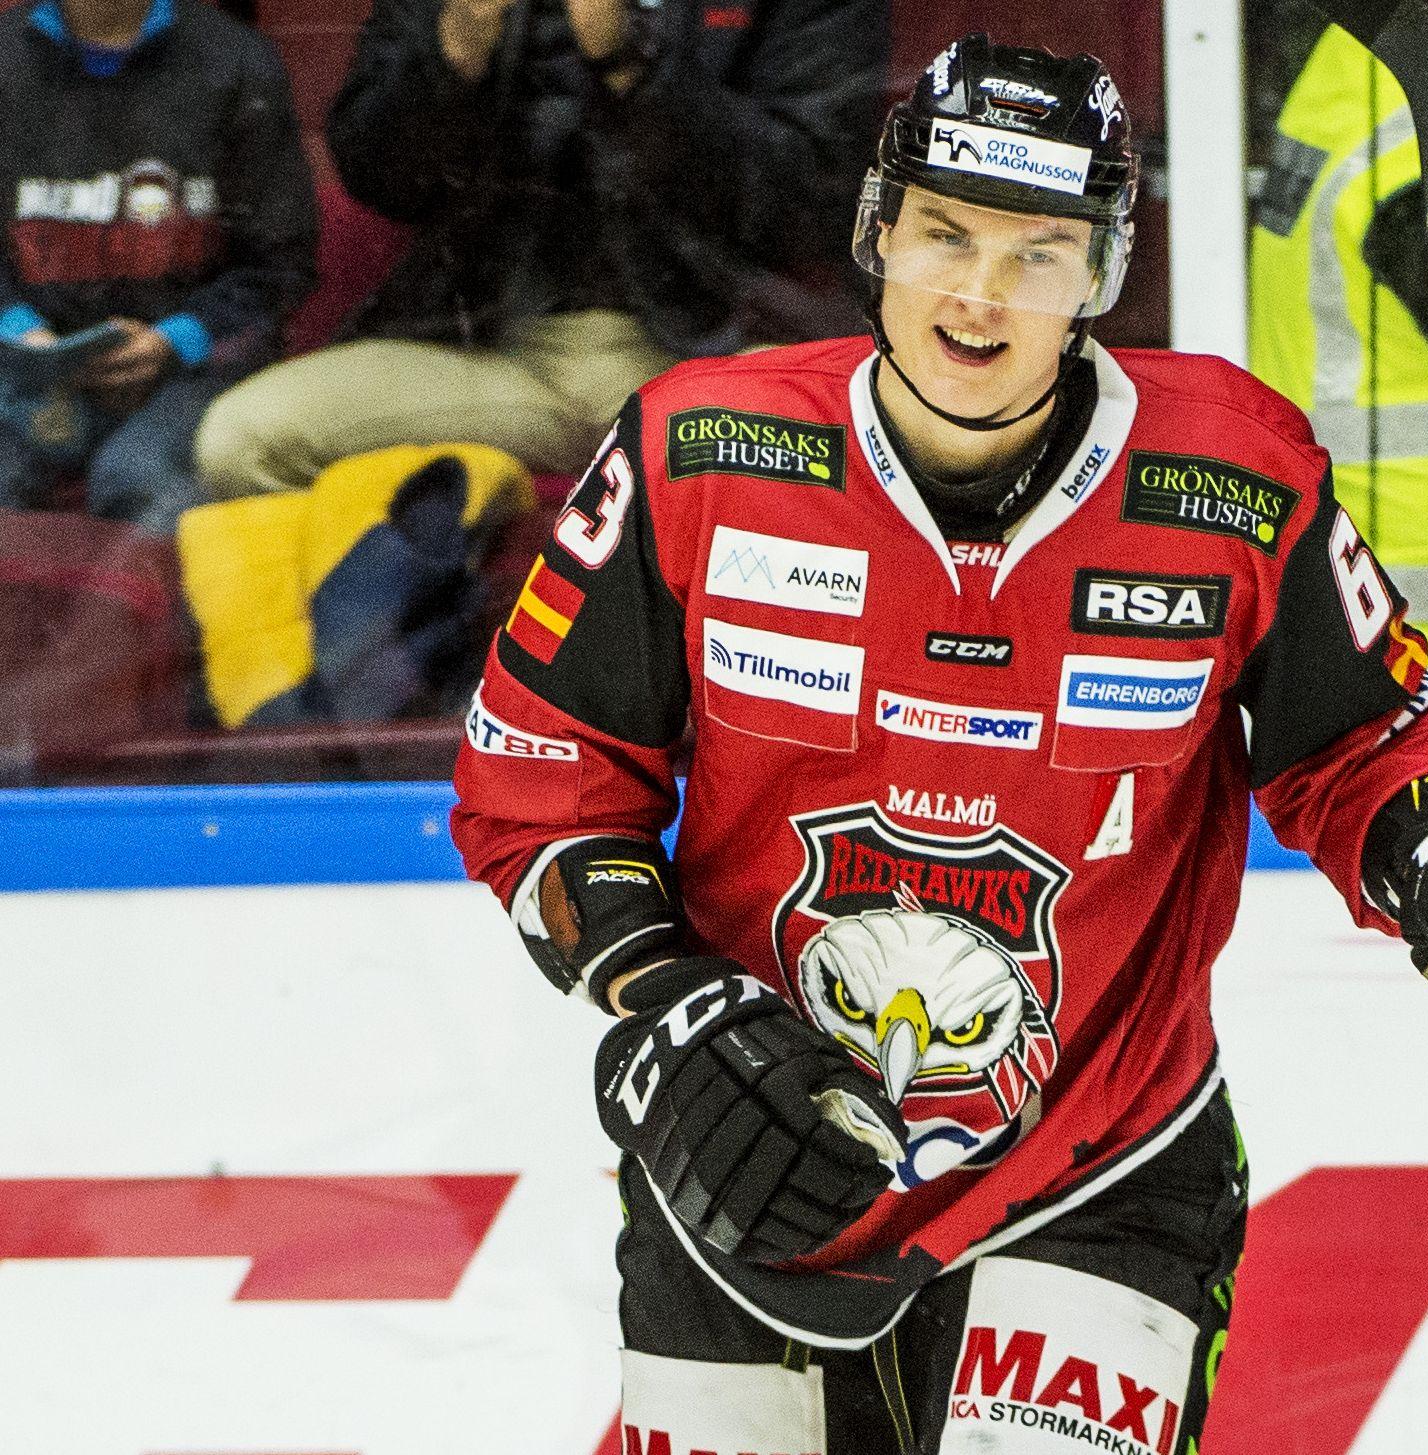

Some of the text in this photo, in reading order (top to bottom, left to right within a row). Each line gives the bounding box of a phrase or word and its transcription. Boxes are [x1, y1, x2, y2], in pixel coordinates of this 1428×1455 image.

[984, 153, 1083, 183] MAGNUSSON
[987, 139, 1028, 157] OTTO
[677, 414, 830, 459] GRÖNSAKS
[716, 440, 809, 472] HUSET
[1060, 443, 1107, 500] bergx
[1141, 465, 1283, 519] GRÖNSAKS
[1178, 495, 1263, 535] HUSET
[787, 567, 862, 593] AVARN
[1086, 582, 1206, 625] RSA
[929, 638, 1010, 660] CCM
[734, 651, 851, 692] Tillmobil
[1076, 681, 1198, 705] EHRENBORG
[903, 705, 1034, 740] INTERSPORT
[886, 784, 997, 827] MALMÖ
[1083, 772, 1135, 861] A
[824, 837, 1031, 938] REDHAWKS
[950, 1400, 981, 1419] ICA
[954, 1327, 1179, 1455] MAXI
